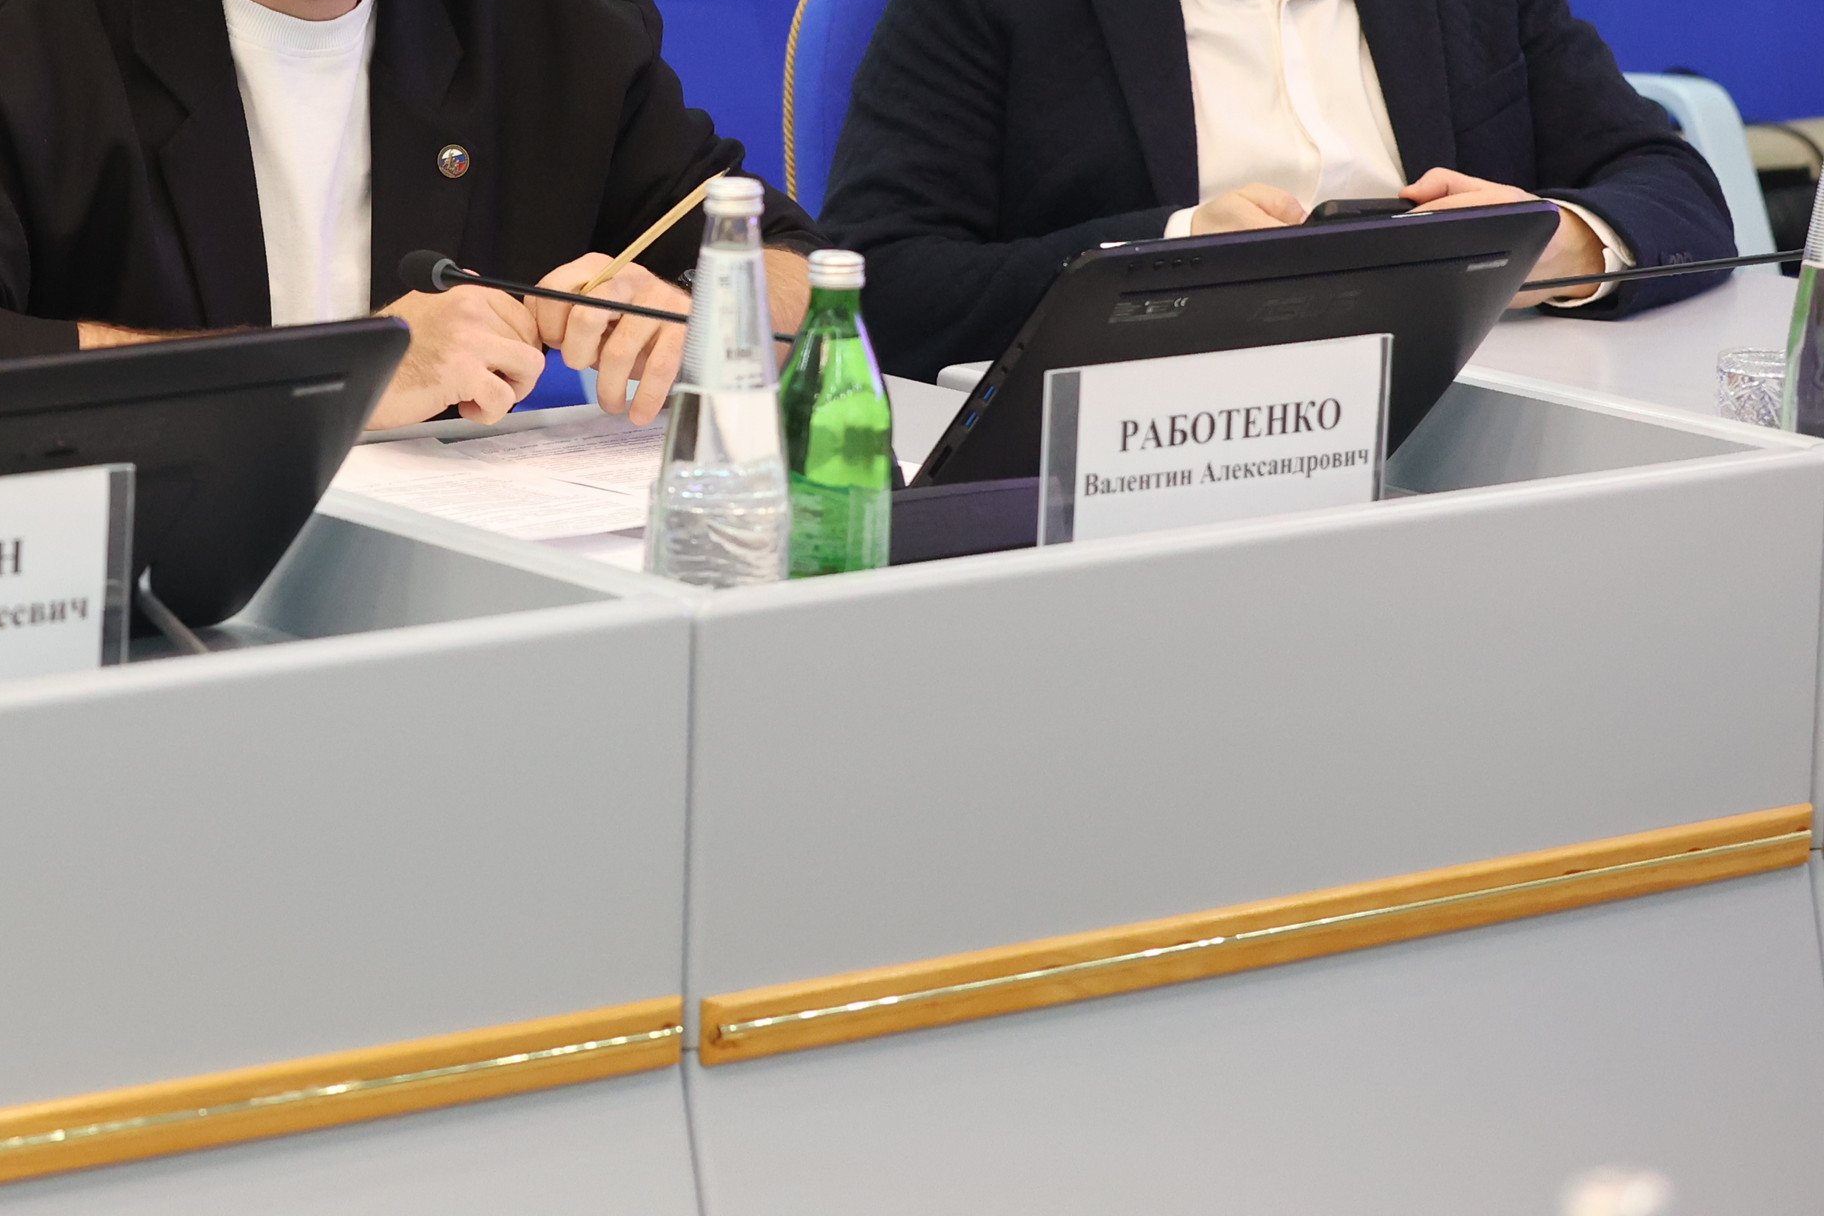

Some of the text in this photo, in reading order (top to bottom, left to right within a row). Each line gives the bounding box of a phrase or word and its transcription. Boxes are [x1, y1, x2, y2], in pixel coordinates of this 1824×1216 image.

[1119, 397, 1343, 453] РАБОТЕНКО
[1083, 448, 1371, 497] Валентин Александрович
